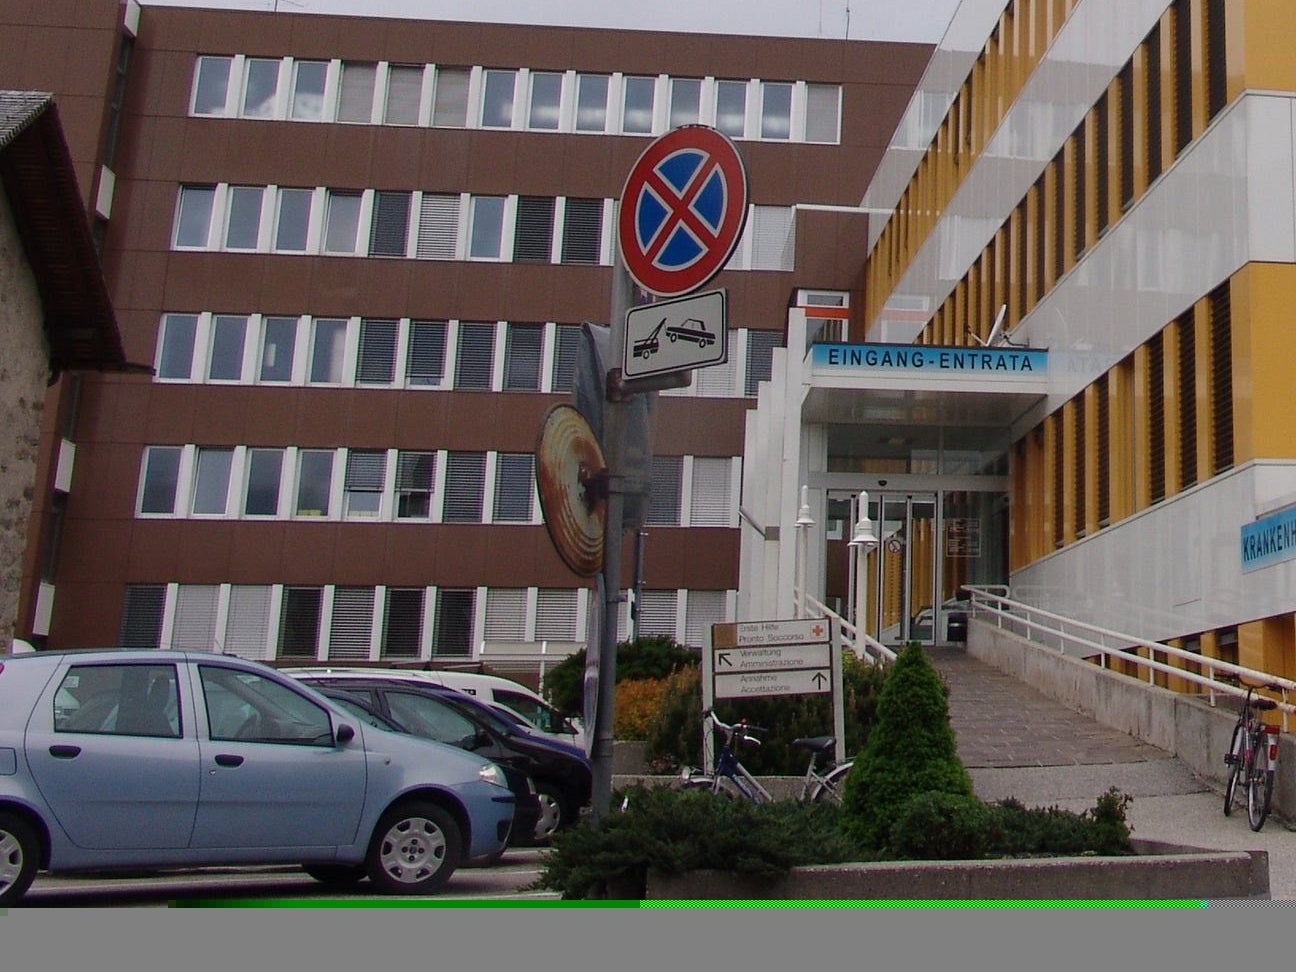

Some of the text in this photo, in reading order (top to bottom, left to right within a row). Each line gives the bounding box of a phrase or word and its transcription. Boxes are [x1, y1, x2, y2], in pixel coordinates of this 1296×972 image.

[761, 623, 779, 631] Hilfe
[739, 633, 805, 643] Pronto Soccorso
[739, 649, 782, 657] Verwaltung
[740, 659, 804, 668] Amministrazione
[740, 685, 791, 693] Accettazione
